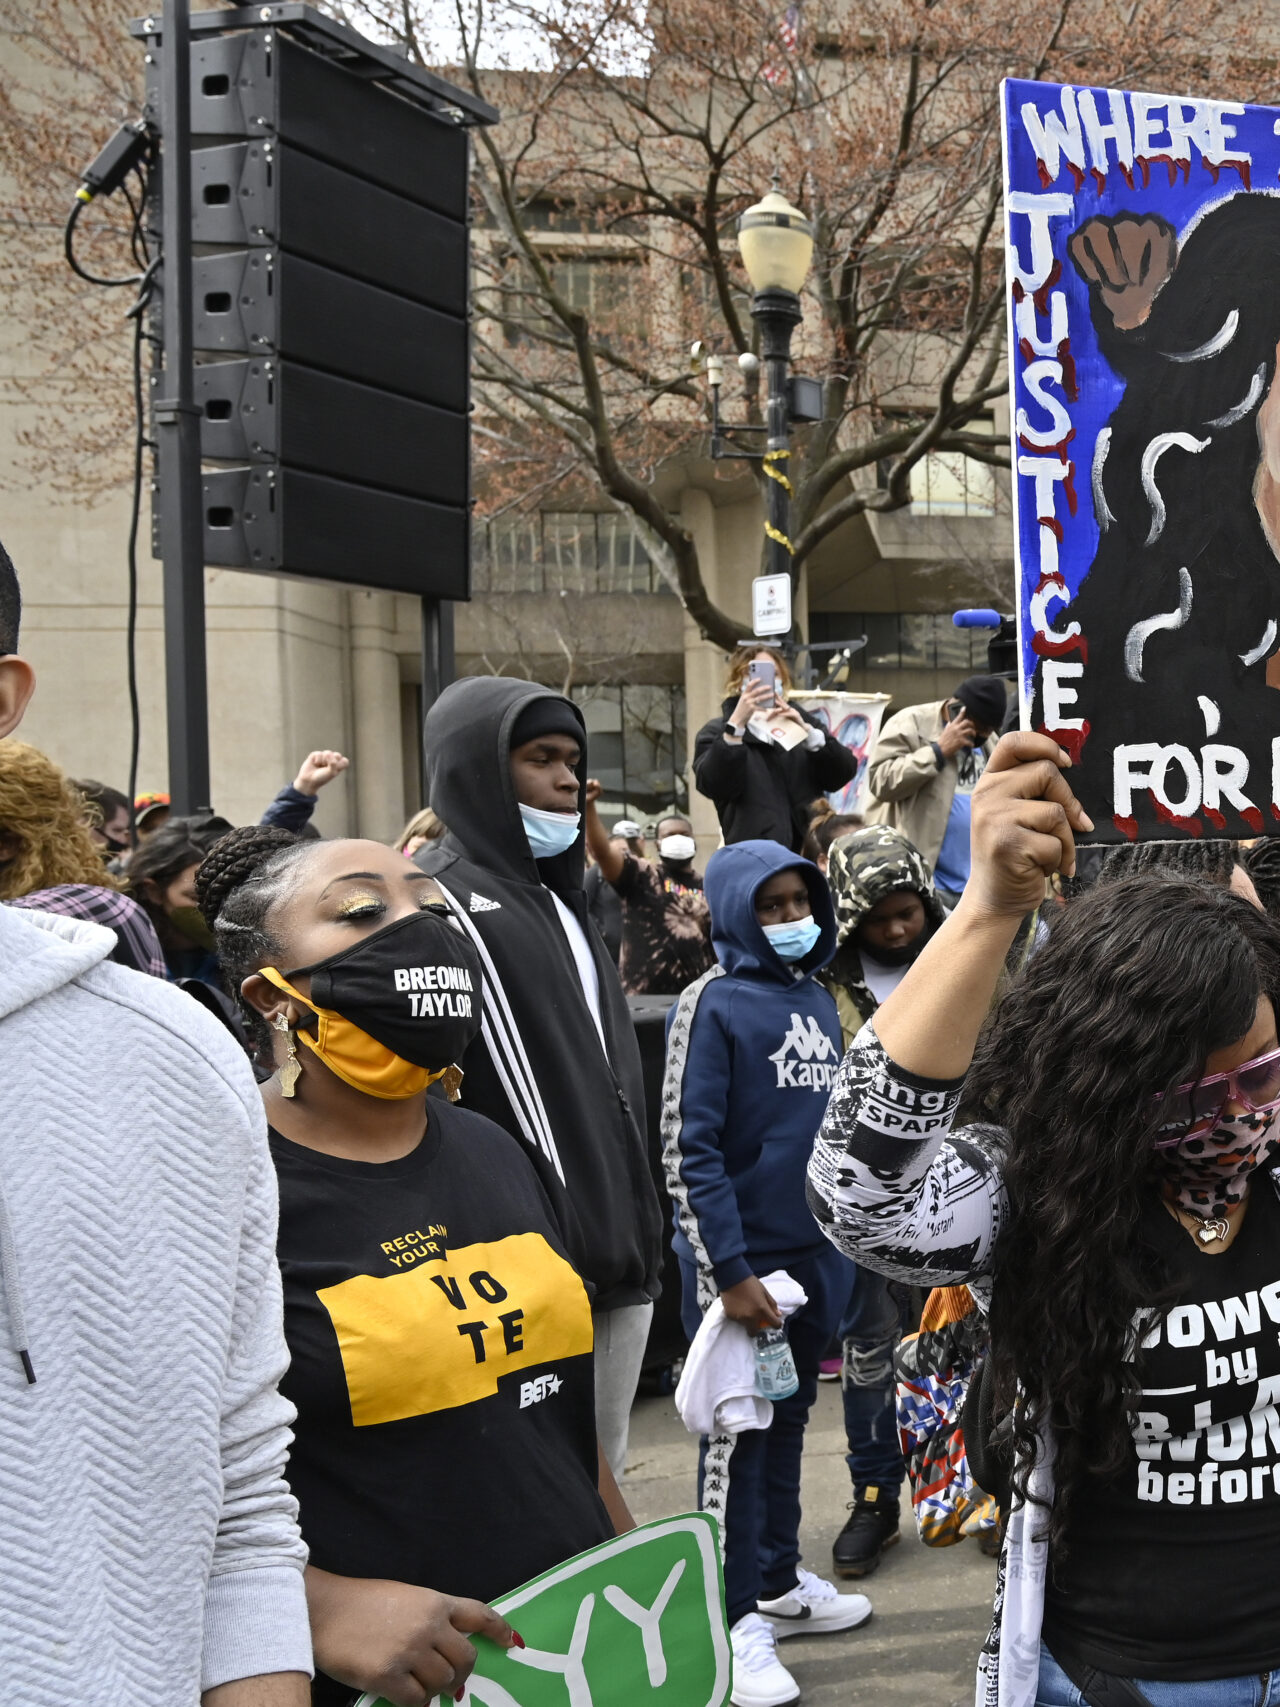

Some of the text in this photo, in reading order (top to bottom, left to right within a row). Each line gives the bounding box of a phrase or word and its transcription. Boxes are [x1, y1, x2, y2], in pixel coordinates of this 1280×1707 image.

[1021, 86, 1252, 178] WHERE
[1008, 191, 1088, 734] JUSTICE
[1112, 741, 1252, 819] FOR
[394, 966, 474, 992] BREONNA
[407, 992, 473, 1018] TAYLOR
[380, 1224, 448, 1255] RECLAIM
[389, 1241, 441, 1269] YOUR
[1205, 1347, 1258, 1389] by
